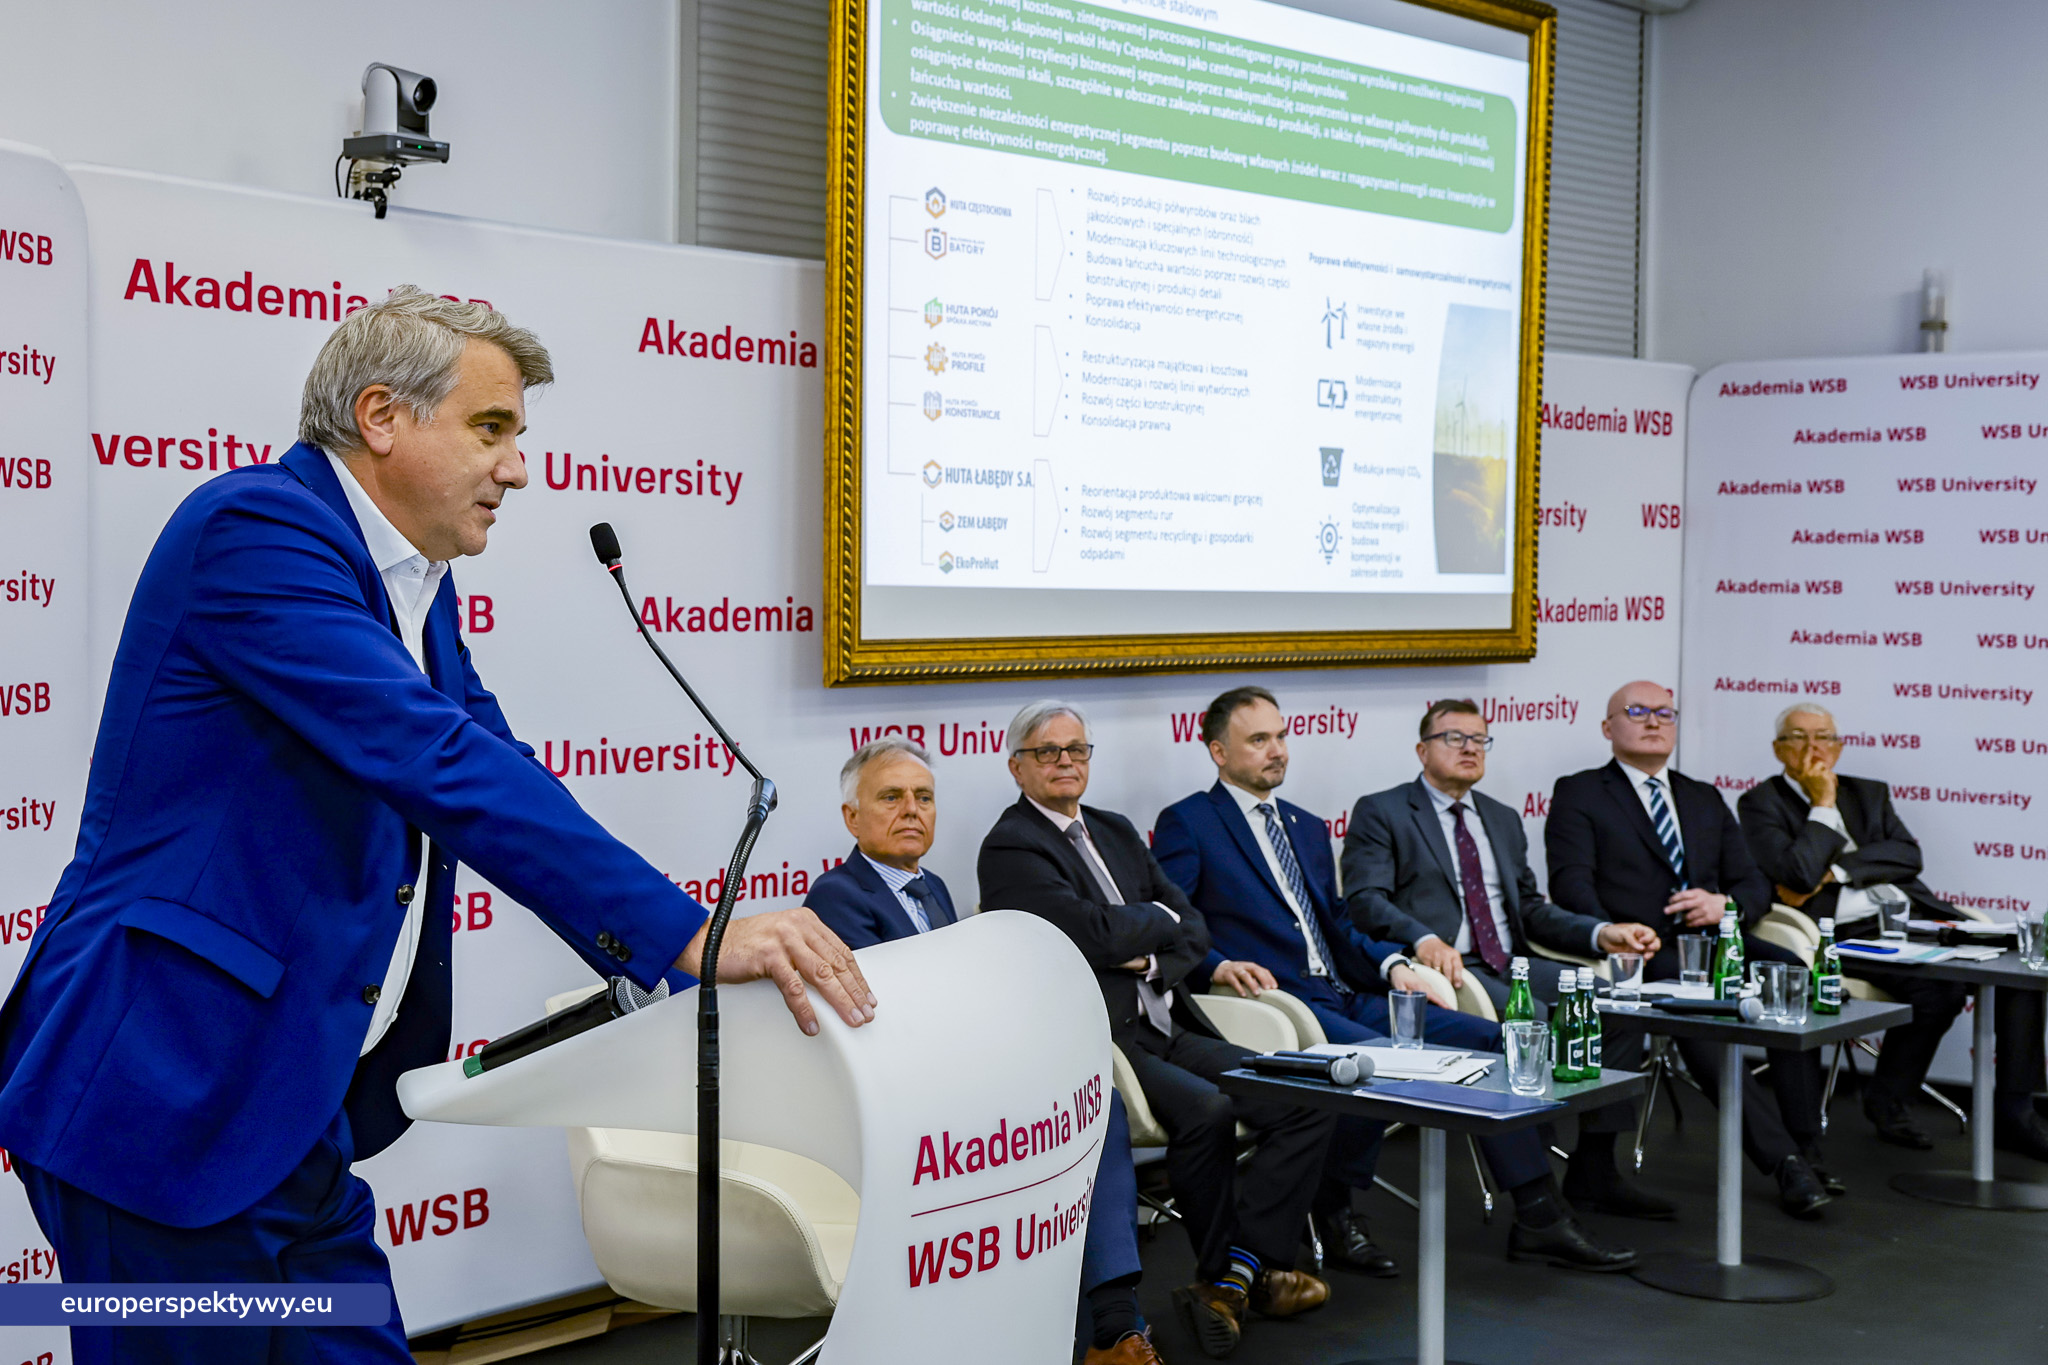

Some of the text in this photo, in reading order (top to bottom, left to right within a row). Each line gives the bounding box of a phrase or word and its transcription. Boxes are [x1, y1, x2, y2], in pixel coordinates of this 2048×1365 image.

[963, 80, 1014, 100] wartości.
[909, 117, 1110, 165] poprawę efektywności energetycznej.
[949, 199, 967, 211] HUTA
[949, 241, 984, 254] BATORY
[945, 303, 970, 315] HUTA
[638, 316, 818, 369] Akademia
[951, 359, 985, 373] PROFILE
[1719, 378, 1848, 397] Akademia WSB
[1899, 371, 2040, 391] WSB University
[944, 406, 1001, 420] KONSTRUKCJE
[1541, 402, 1674, 437] Akademia WSB
[1793, 426, 1927, 444] Akademia WSB
[1981, 424, 2022, 439] WSB
[545, 452, 744, 506] University
[945, 466, 973, 484] HUTA
[974, 468, 1013, 487] ŁABĘDY
[1897, 476, 2037, 495] WSB University
[1717, 479, 1845, 495] Akademia WSB
[976, 516, 1008, 531] ŁABĘDY
[1537, 501, 1588, 534] ersity
[1641, 503, 1682, 530] WSB
[1791, 529, 1924, 544] Akademia WSB
[1979, 529, 2020, 544] WSB
[955, 556, 999, 570] EkoProHut
[1715, 579, 1843, 595] Akademia WSB
[1895, 580, 2035, 600] WSB University
[636, 596, 815, 633] Akademia
[1625, 595, 1666, 622] WSB
[1790, 629, 1923, 647] Akademia WSB
[1977, 633, 2018, 649] WSB
[1714, 677, 1841, 695] Akademia WSB
[1893, 683, 2033, 705] WSB University
[1284, 704, 1360, 739] versity
[1482, 693, 1580, 732] University
[1881, 733, 1921, 749] WSB
[1975, 738, 2016, 754] WSB
[544, 733, 741, 778] University
[1892, 785, 2032, 811] WSB University
[1974, 842, 2015, 858] WSB
[912, 1073, 1102, 1186] Akademia WSB
[385, 1187, 490, 1247] WSB
[907, 1225, 1001, 1289] WSB
